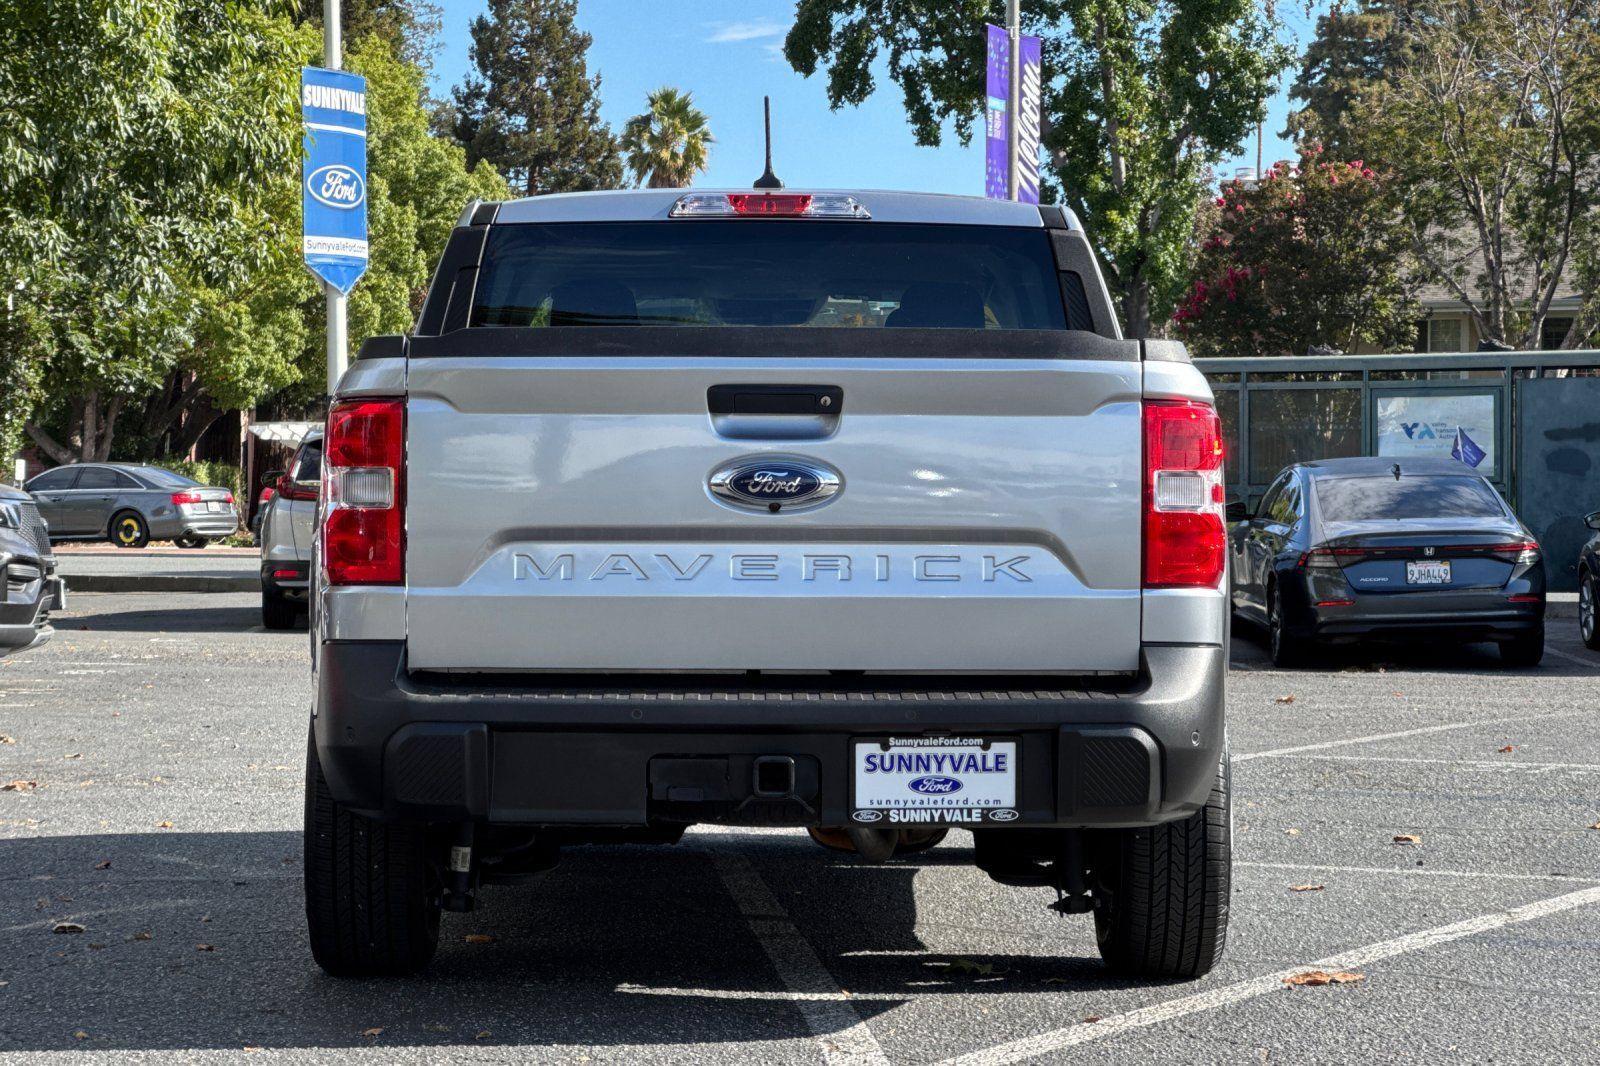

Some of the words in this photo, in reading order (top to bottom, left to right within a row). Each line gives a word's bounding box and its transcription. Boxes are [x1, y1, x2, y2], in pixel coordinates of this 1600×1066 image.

[303, 84, 365, 115] SUNNYVALE
[321, 169, 357, 201] Ford
[748, 470, 801, 493] Ford
[512, 553, 1034, 582] MAVERICK
[888, 737, 984, 748] SunnyvaleFord.com
[864, 752, 1008, 774] SUNNYVALE
[918, 776, 953, 793] Ford
[869, 797, 1002, 807] sunnyvaleford.com
[889, 809, 982, 823] SUNNYVALE
